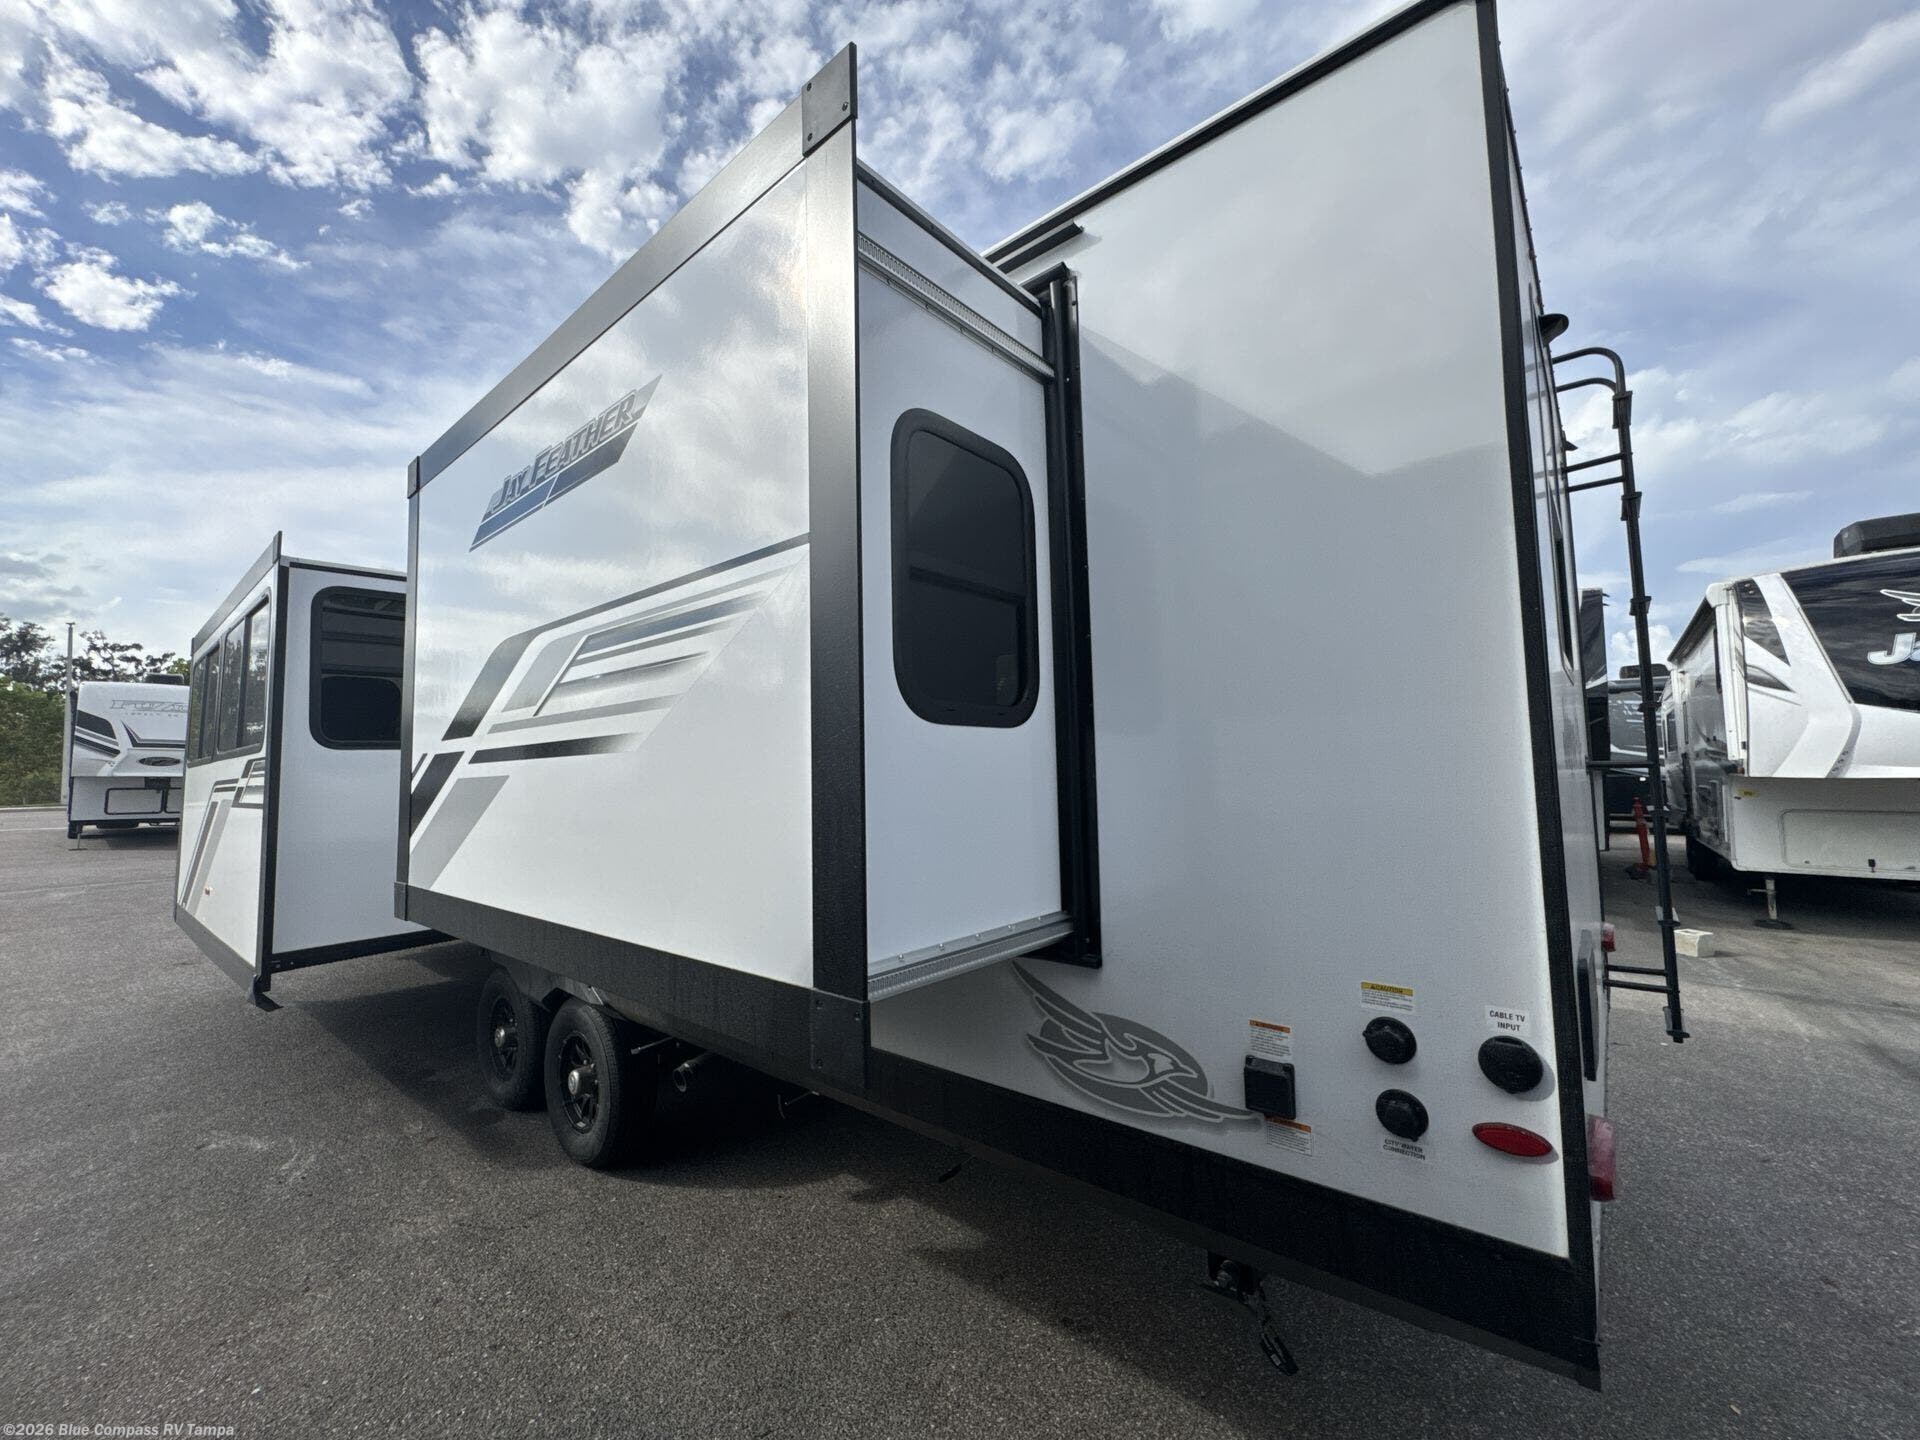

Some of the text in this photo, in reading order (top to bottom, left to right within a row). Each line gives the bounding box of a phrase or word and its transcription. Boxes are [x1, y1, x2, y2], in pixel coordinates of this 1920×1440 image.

[528, 389, 637, 488] FEATHER
[1489, 1009, 1525, 1022] CABLE TV
[1497, 1021, 1520, 1031] INPUT
